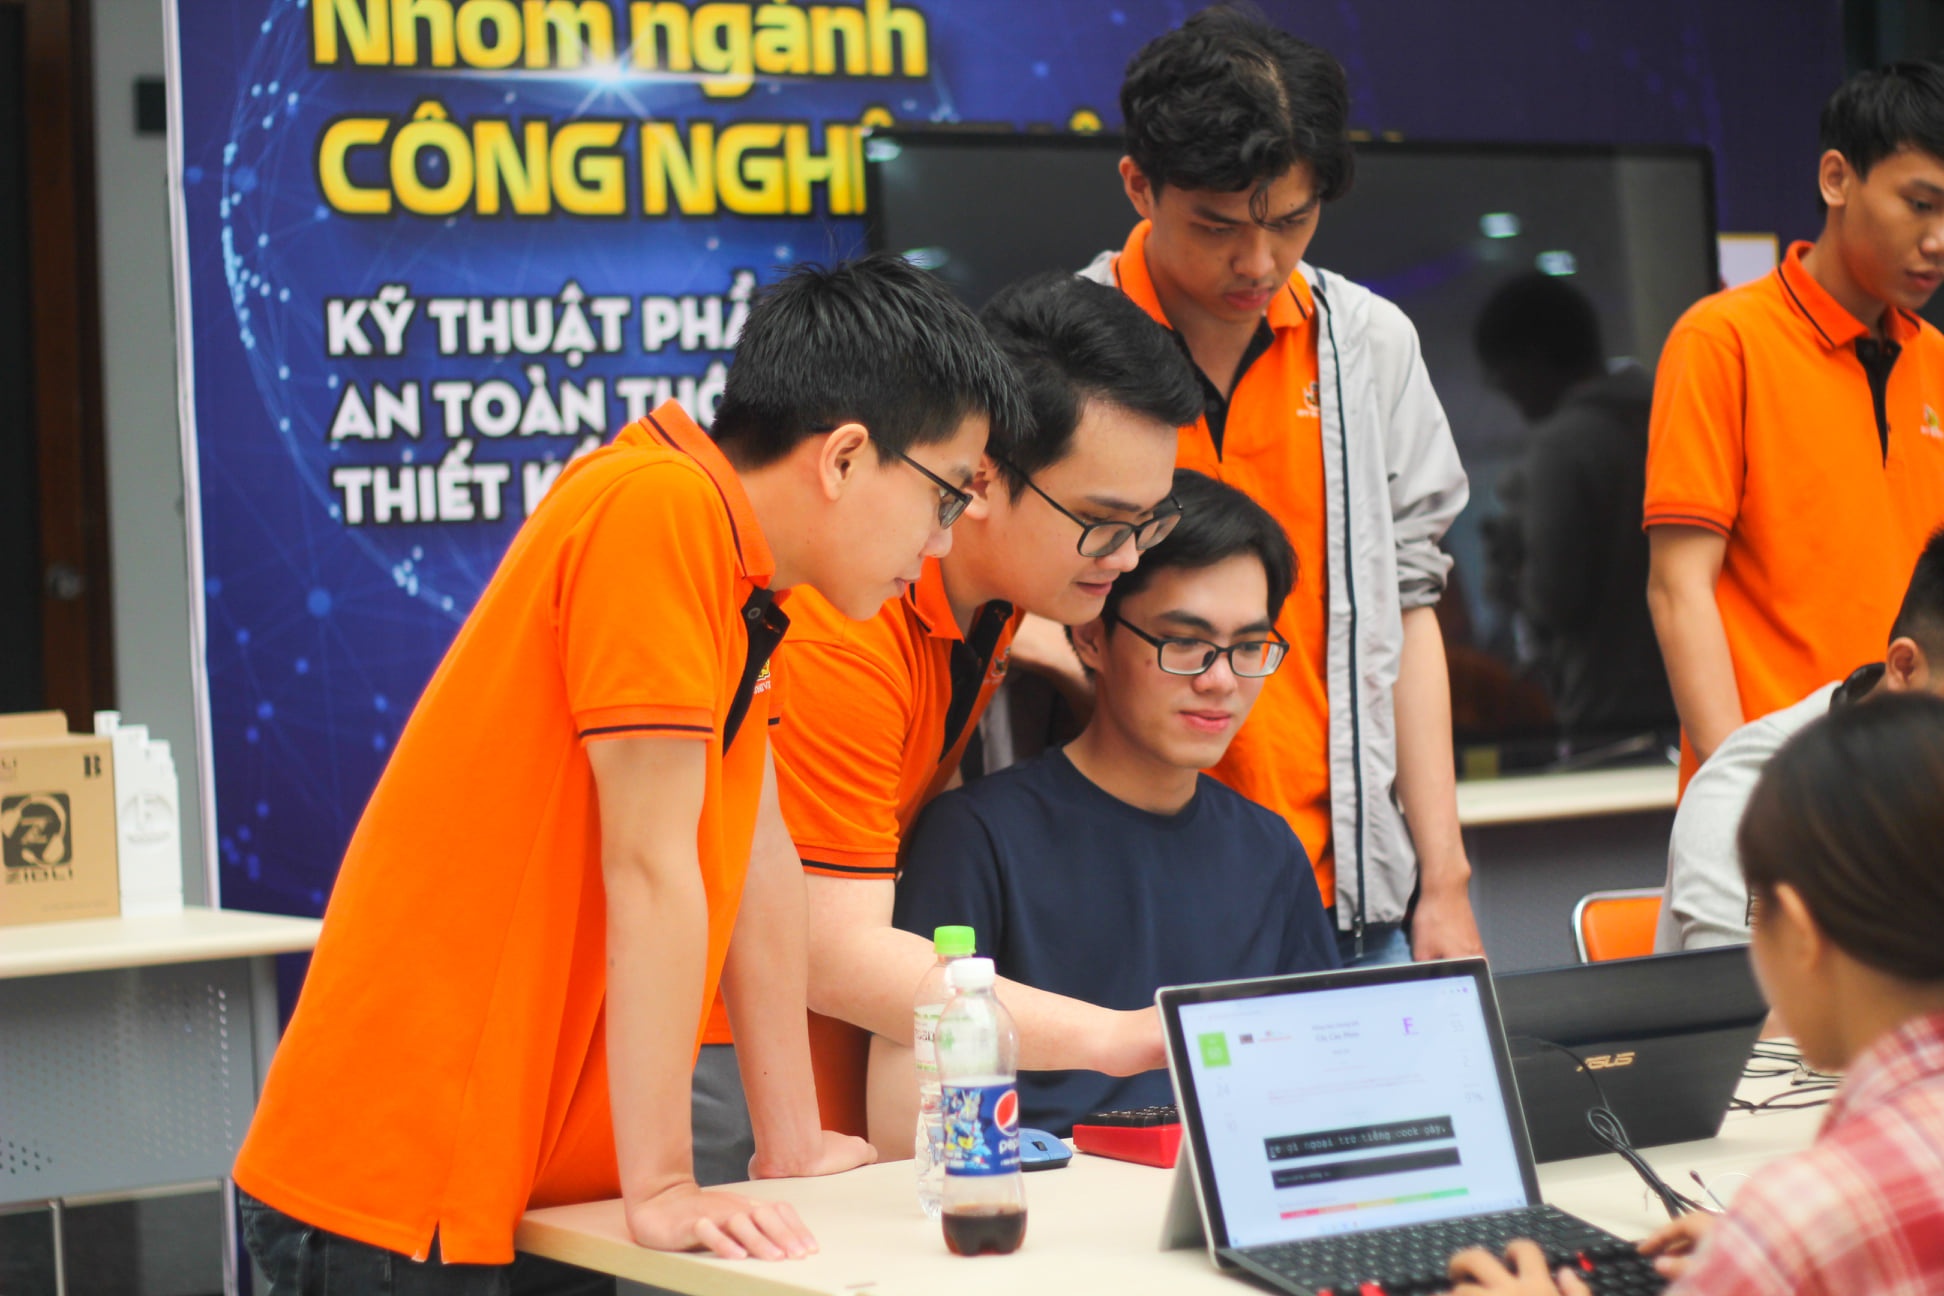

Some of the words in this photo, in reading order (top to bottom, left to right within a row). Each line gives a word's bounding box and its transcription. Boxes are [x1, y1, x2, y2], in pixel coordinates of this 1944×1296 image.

[318, 101, 627, 215] CÔNG
[327, 284, 416, 355] KỸ
[427, 281, 631, 368] THUẬT
[331, 381, 421, 440] AN
[432, 364, 607, 438] TOÀN
[332, 439, 510, 524] THIẾT
